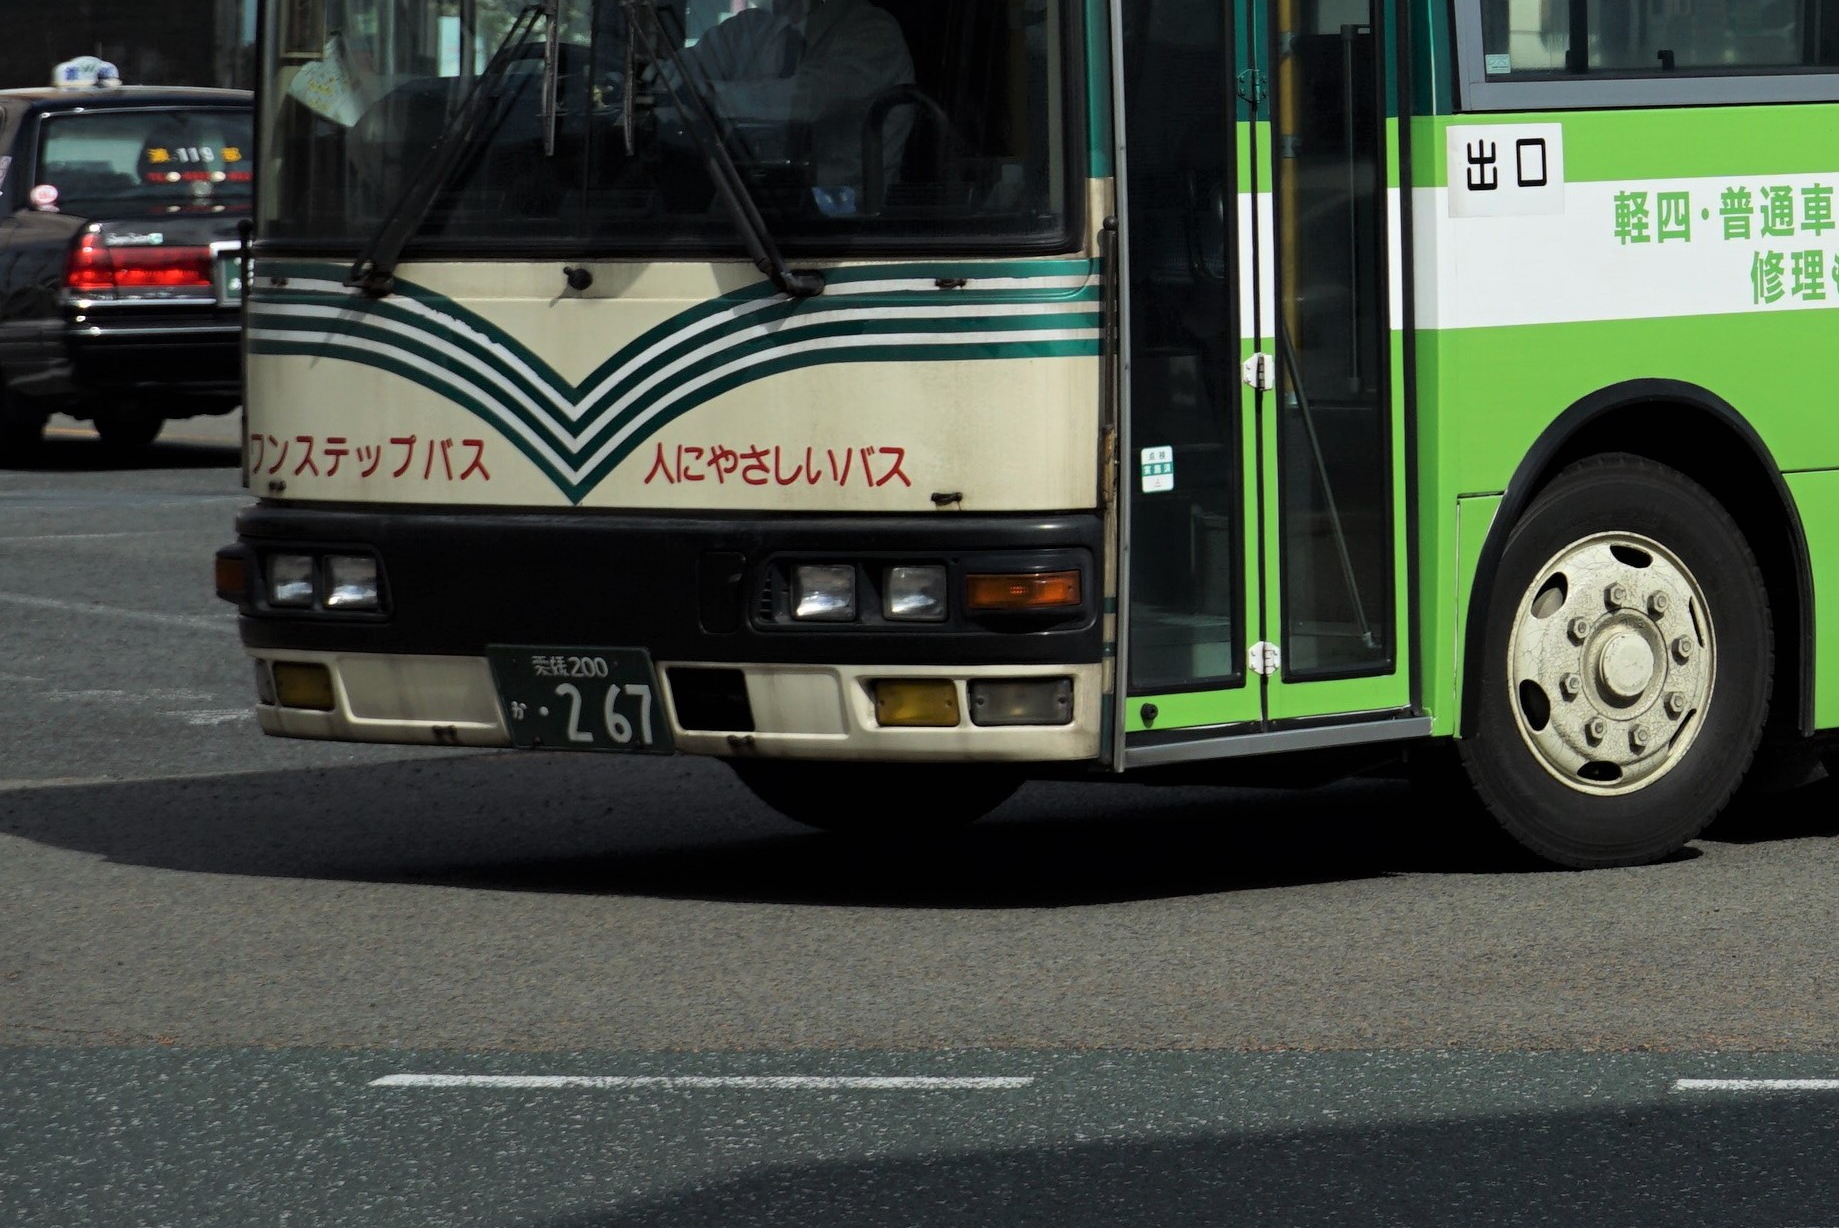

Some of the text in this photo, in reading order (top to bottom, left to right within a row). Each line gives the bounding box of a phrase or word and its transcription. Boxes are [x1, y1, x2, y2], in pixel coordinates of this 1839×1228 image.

[1466, 138, 1548, 191] 出口
[643, 441, 912, 488] 人にやさしいバス
